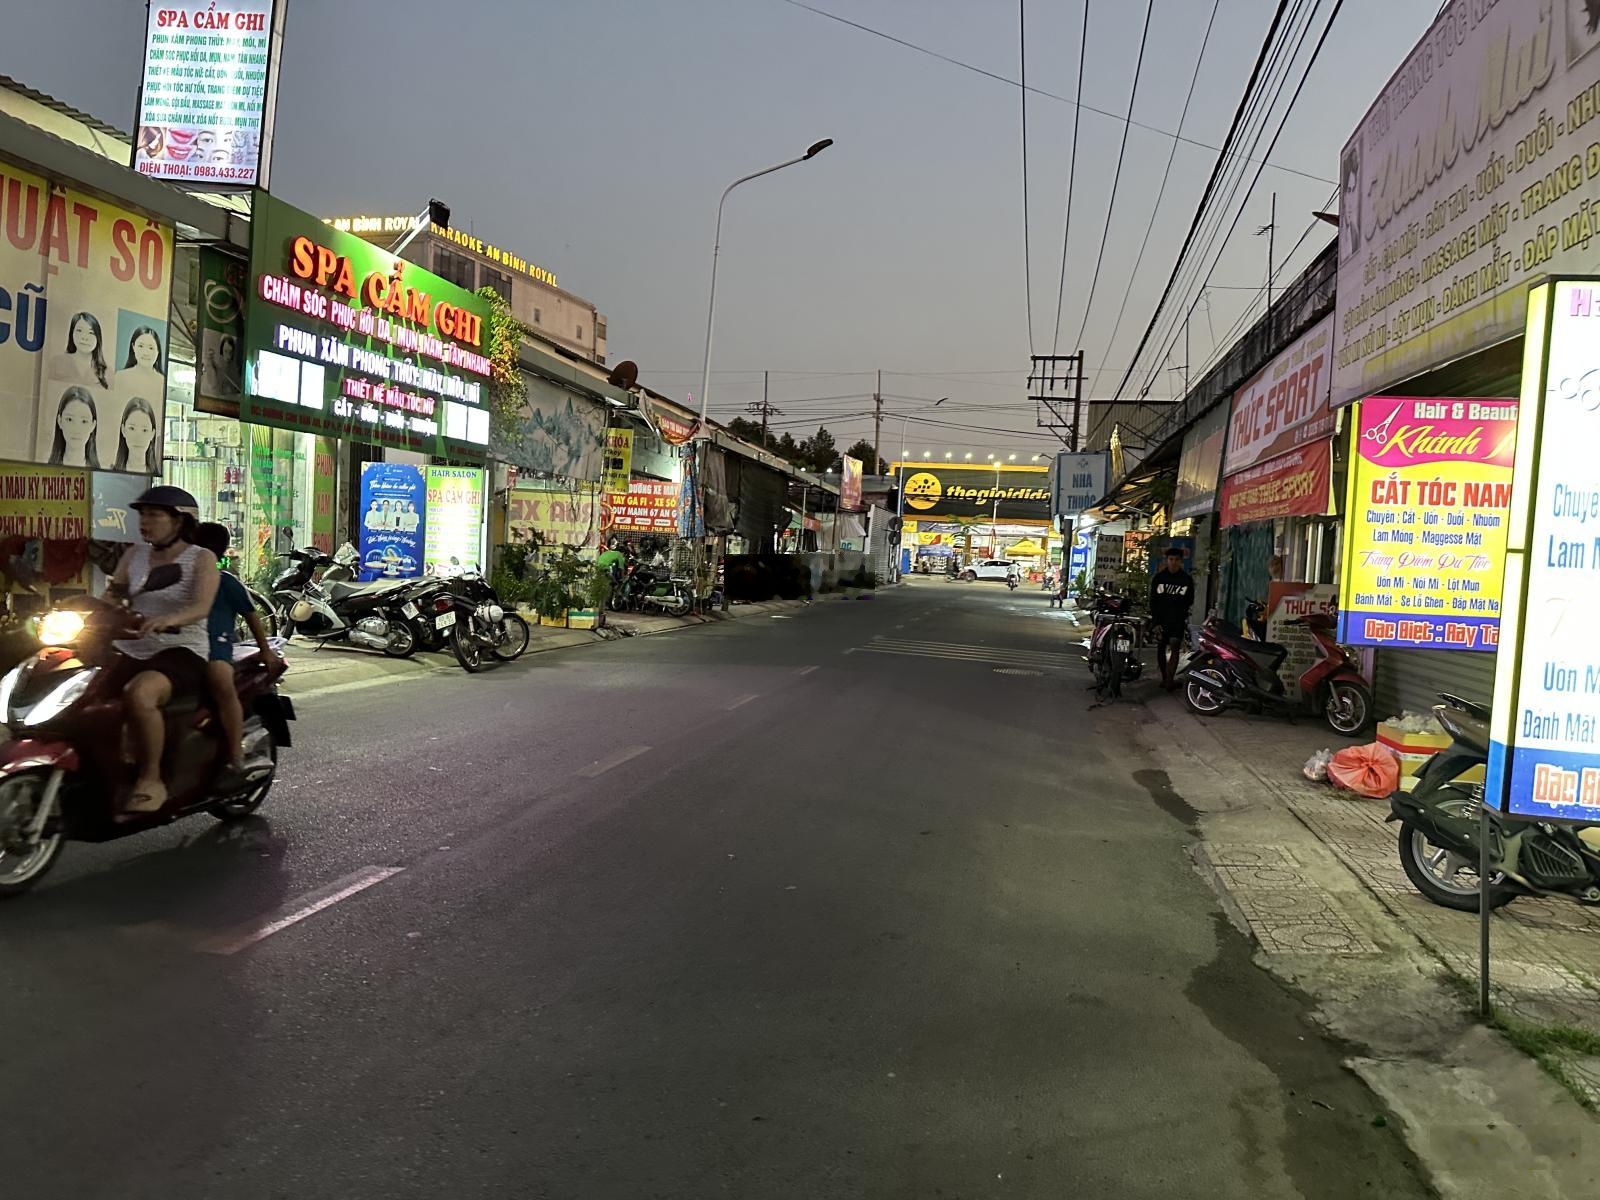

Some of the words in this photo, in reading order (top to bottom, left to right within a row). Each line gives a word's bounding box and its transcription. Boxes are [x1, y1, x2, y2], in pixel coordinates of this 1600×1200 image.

[157, 10, 188, 28] SPA
[194, 1, 230, 30] CẨM
[235, 12, 264, 30] GHI
[186, 35, 206, 46] PHONG
[192, 100, 214, 109] MASSAGE
[194, 166, 254, 179] 0983.433.227
[1448, 184, 1468, 222] TAI
[1476, 151, 1504, 200] UỐN
[352, 216, 381, 232] BÌNH
[1422, 224, 1476, 284] MASSAGE
[1479, 202, 1510, 248] MẶT
[1521, 154, 1582, 220] TRANG
[0, 174, 98, 276] UẬT
[110, 217, 164, 290] SỐ
[431, 222, 483, 254] KARAOKE
[486, 245, 500, 262] AN
[502, 251, 526, 274] BÌNH
[530, 264, 557, 288] ROYAL
[291, 236, 357, 298] SPA
[362, 260, 431, 328] CẨM
[435, 302, 482, 346] GHI
[1412, 296, 1435, 332] MỤN
[1442, 275, 1477, 314] ĐÁNH
[1480, 247, 1512, 295] MẮT
[303, 288, 327, 319] SÓC
[330, 300, 356, 335] PHỤC
[466, 351, 490, 376] NHANG
[278, 324, 316, 359] PHUN
[352, 347, 391, 378] PHONG
[1264, 353, 1324, 436] SPORT
[334, 396, 353, 417] CẮT
[1414, 402, 1448, 419] Hair
[1452, 402, 1464, 419] &
[1468, 403, 1518, 420] Beaut
[1371, 424, 1484, 458] Khánh
[452, 470, 477, 478] SALON
[6, 472, 26, 499] MÀU
[42, 473, 70, 504] THUẬT
[73, 472, 85, 500] SỐ
[428, 489, 443, 503] SPA
[654, 485, 662, 494] XE
[1371, 471, 1411, 505] CẮT
[1417, 476, 1456, 506] TÓC
[1463, 482, 1512, 508] NAM
[613, 496, 625, 505] TAY
[627, 496, 638, 505] GA
[640, 497, 647, 506] FI
[655, 498, 664, 507] XE
[650, 509, 658, 517] 67
[660, 508, 670, 517] AN
[1366, 510, 1395, 527] Chuyên
[1422, 531, 1463, 546] Maggesse
[1393, 576, 1404, 588] Mi
[1428, 578, 1439, 590] Mi
[1355, 593, 1374, 605] Đánh
[1400, 595, 1410, 607] Se
[1488, 599, 1499, 612] Nạ
[1365, 619, 1395, 642] Đặc
[1398, 620, 1434, 643] Biệt
[1482, 624, 1500, 644] Ta
[1585, 664, 1600, 694] M
